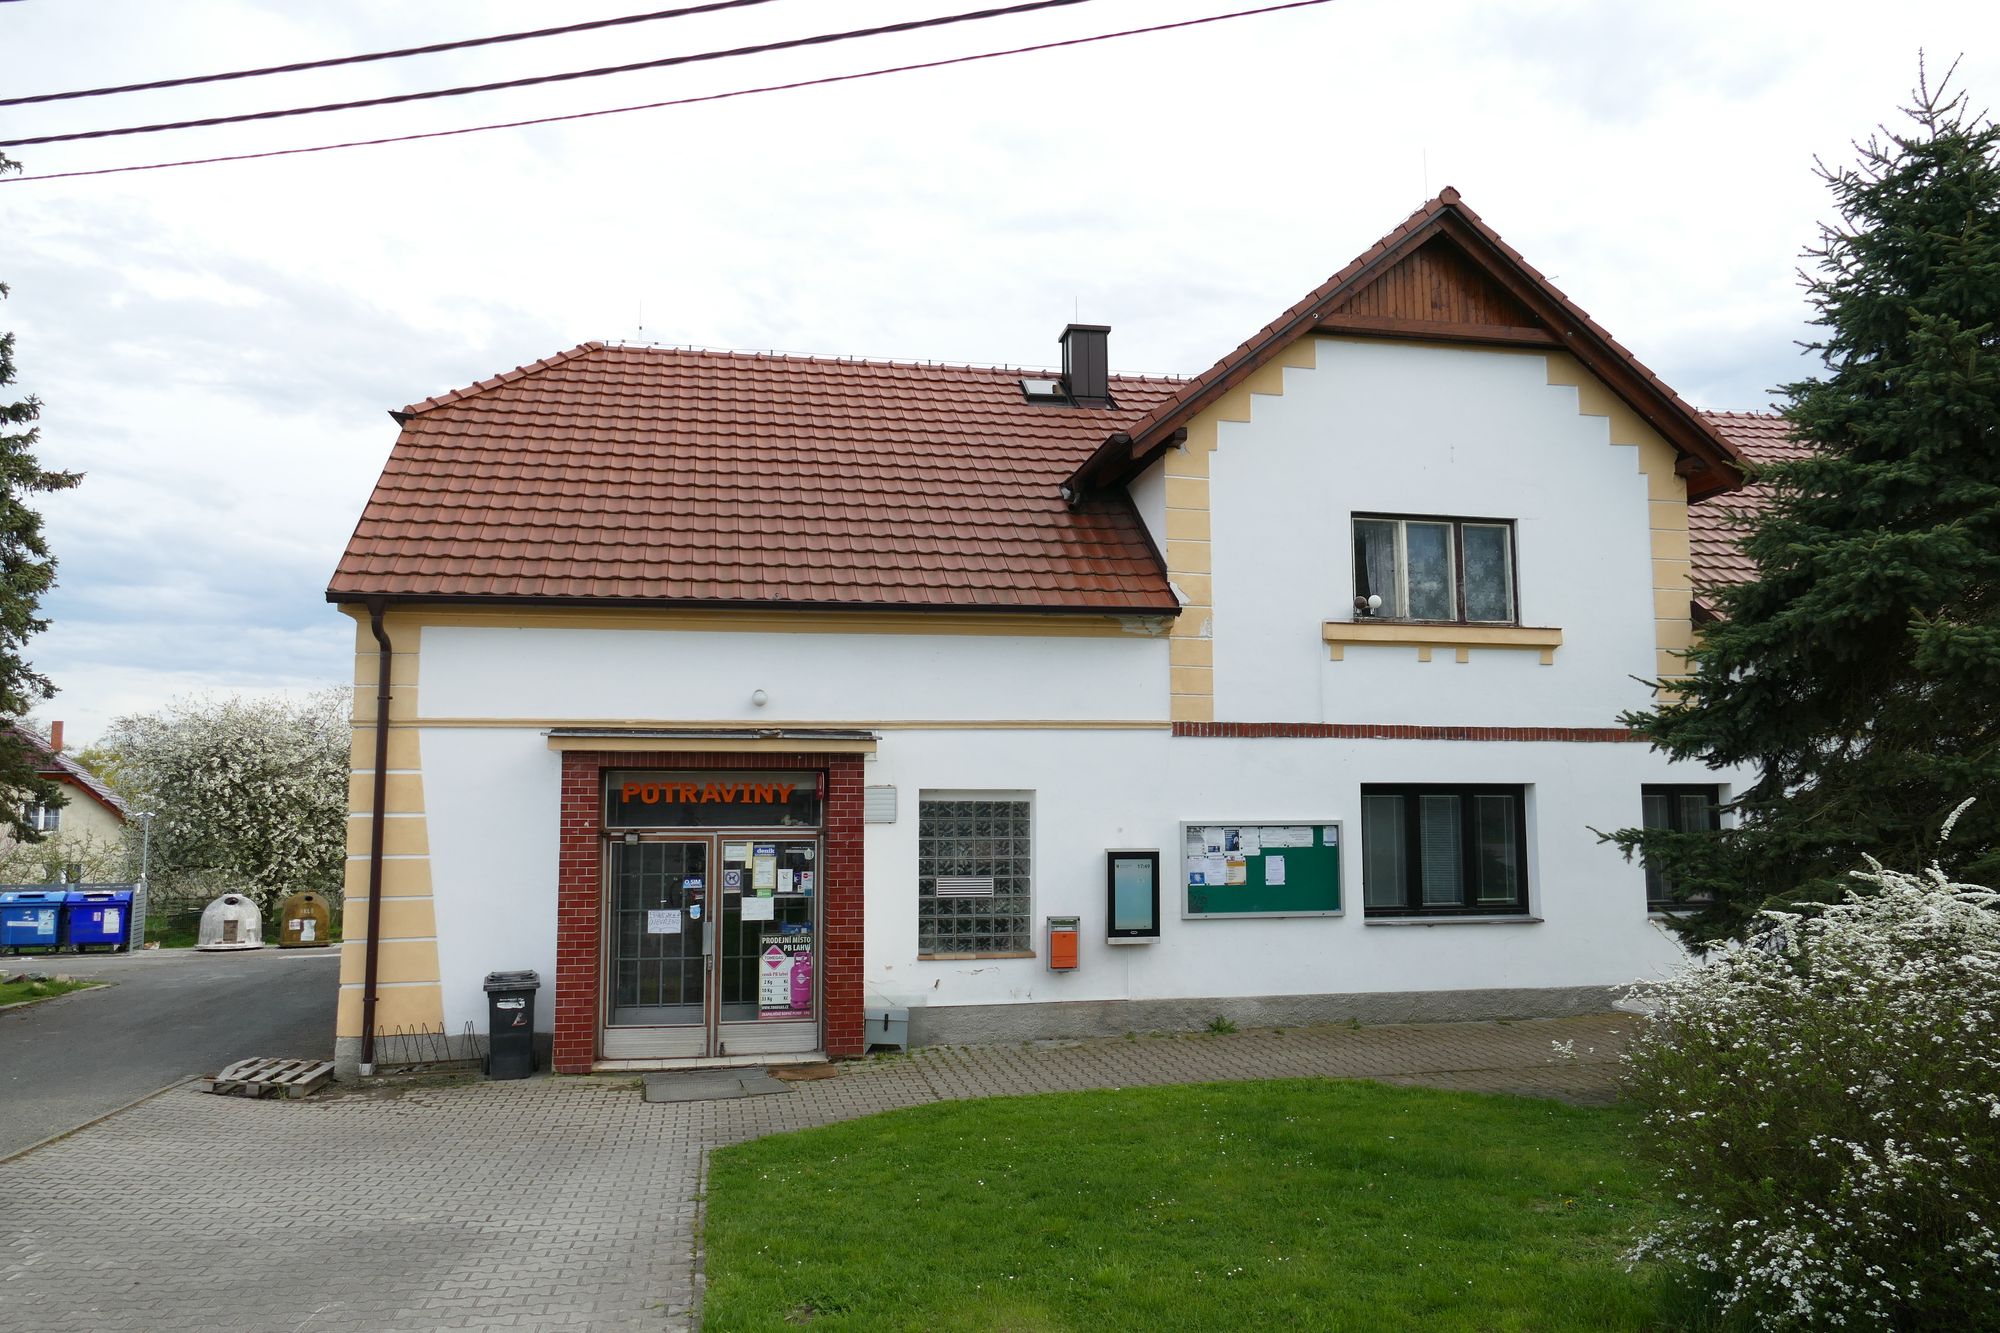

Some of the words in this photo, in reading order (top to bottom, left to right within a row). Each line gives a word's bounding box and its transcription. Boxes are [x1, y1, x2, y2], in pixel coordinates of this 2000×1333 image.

[622, 782, 796, 805] POTRAVINY
[762, 936, 791, 944] PRODEJNÍ
[792, 935, 811, 943] MÍSTO
